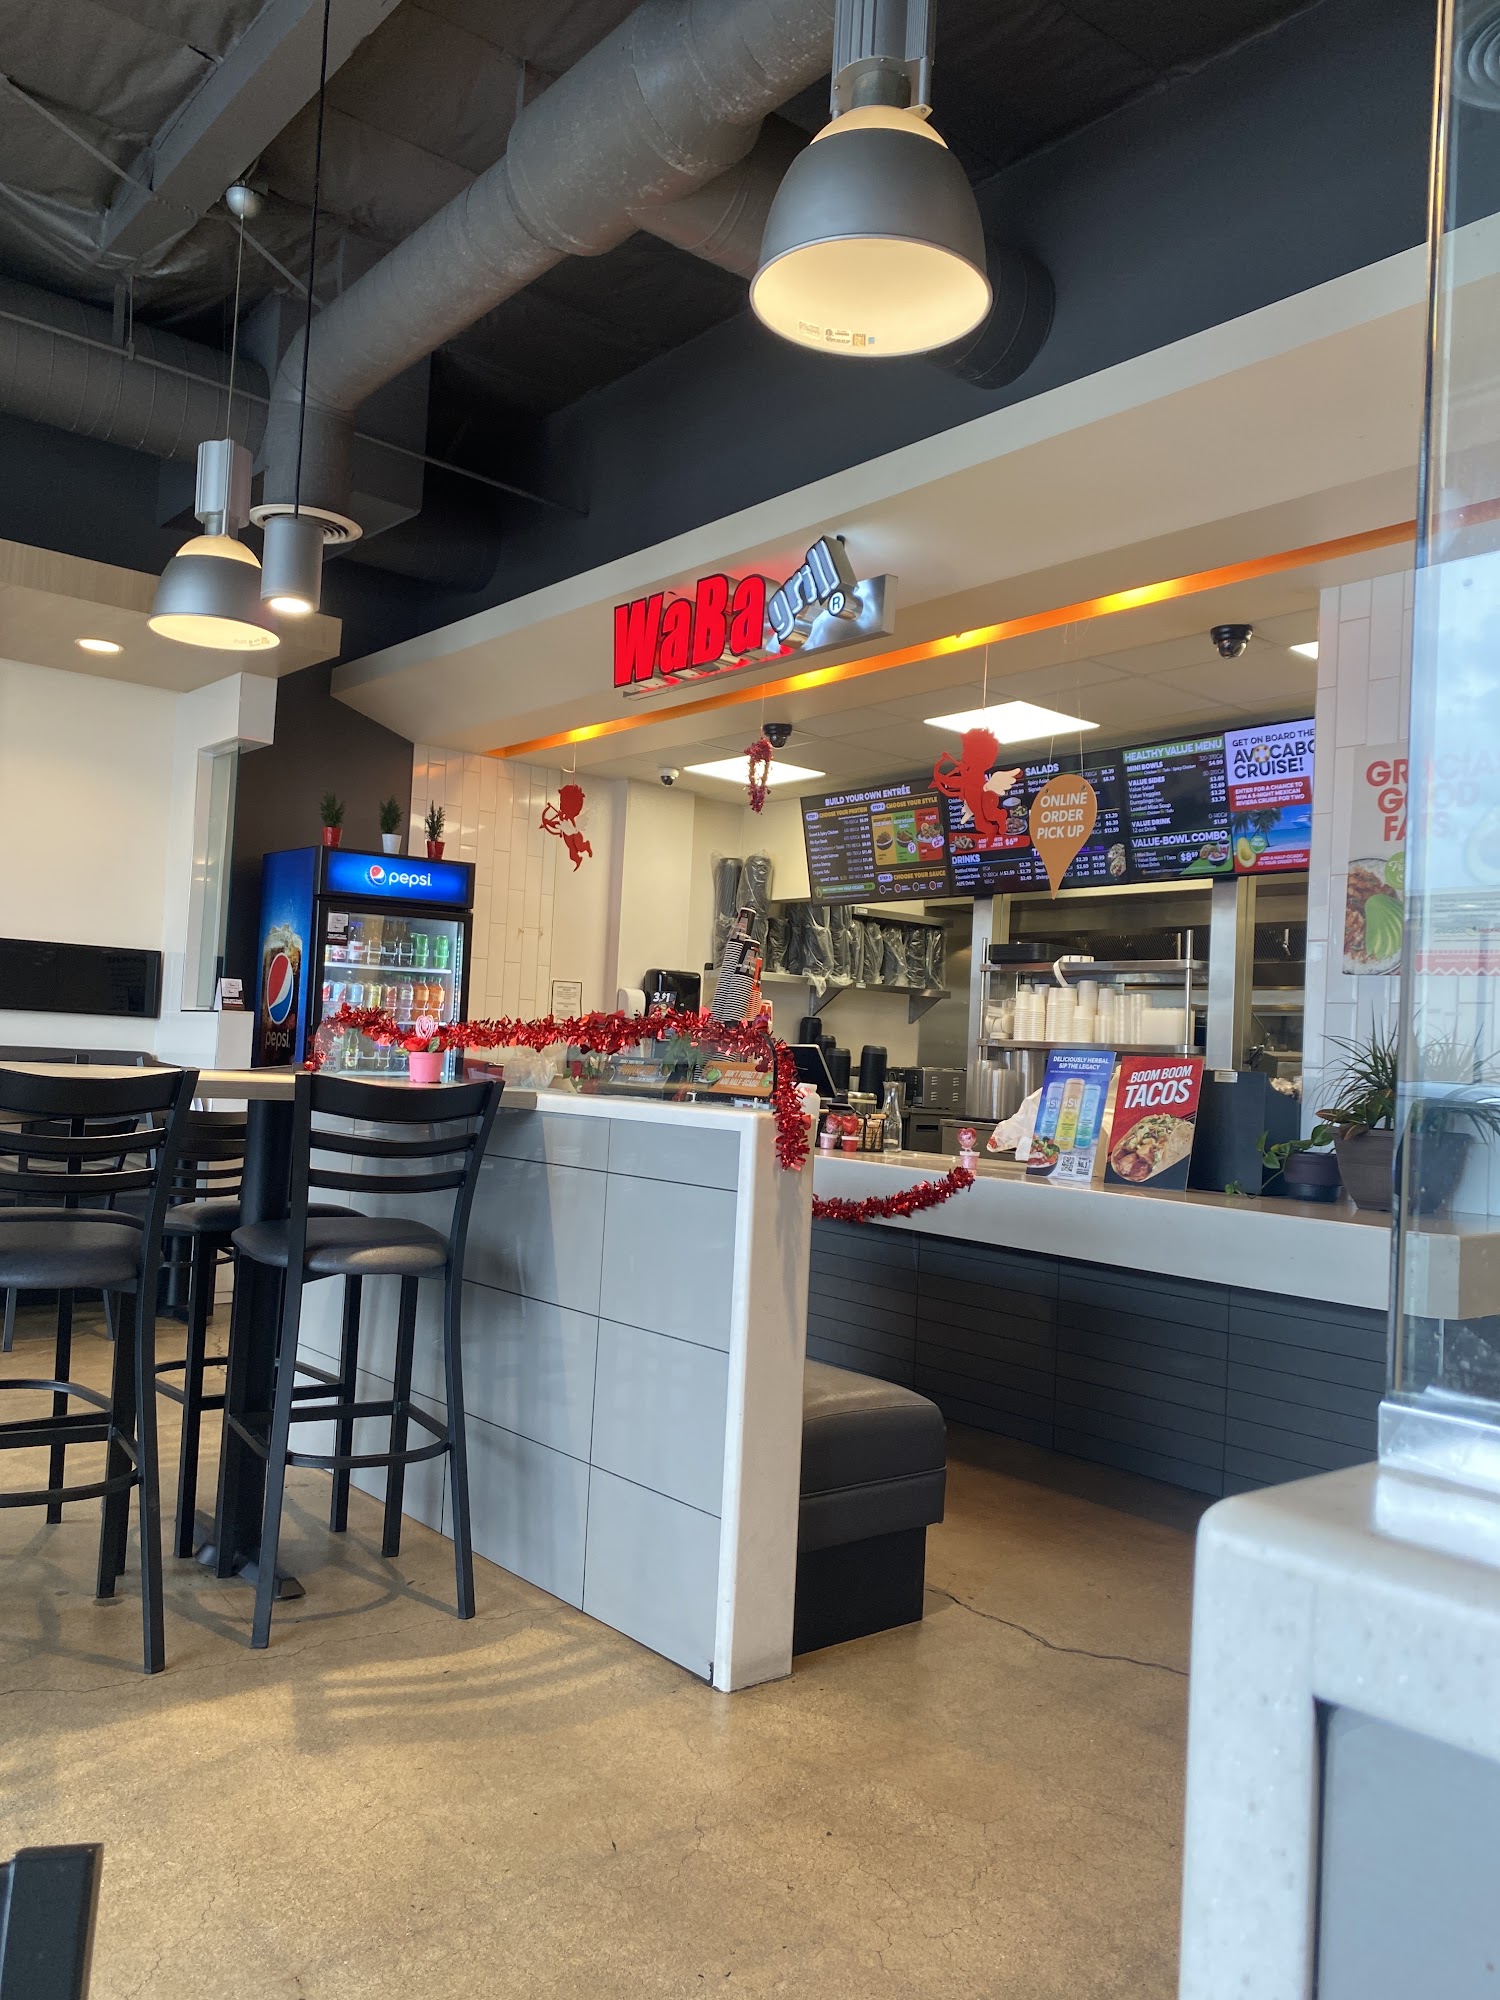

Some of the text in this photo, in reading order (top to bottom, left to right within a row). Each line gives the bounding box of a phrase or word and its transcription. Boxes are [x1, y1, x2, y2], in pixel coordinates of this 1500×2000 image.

[614, 538, 841, 689] WaBa grill
[1232, 729, 1315, 747] GET ON BOARD THE
[1124, 739, 1223, 762] HEALTHY VALUE MENU
[1025, 763, 1059, 776] SALADS
[1142, 761, 1163, 770] BOWLS
[1234, 757, 1304, 779] CRUISE!
[1128, 775, 1165, 786] VALUE SIDES
[1271, 782, 1295, 790] CHANCE
[825, 784, 911, 806] BUILD YOUR OWN ENTRÉE
[1040, 791, 1088, 808] ONLINE
[1258, 796, 1278, 804] CRUISE
[1291, 793, 1305, 801] TWO
[1275, 788, 1301, 796] MEXICAN
[1041, 809, 1084, 824] ORDER
[1131, 820, 1151, 828] VALUE
[1037, 825, 1085, 839] PICK UP
[1131, 830, 1228, 848] VALUE-BOWL COMBO
[952, 854, 981, 864] DRINKS
[389, 872, 432, 888] pepsi
[265, 1029, 291, 1051] pepsi
[1130, 1064, 1194, 1083] BOOM BOOM
[1124, 1078, 1194, 1109] TACOS
